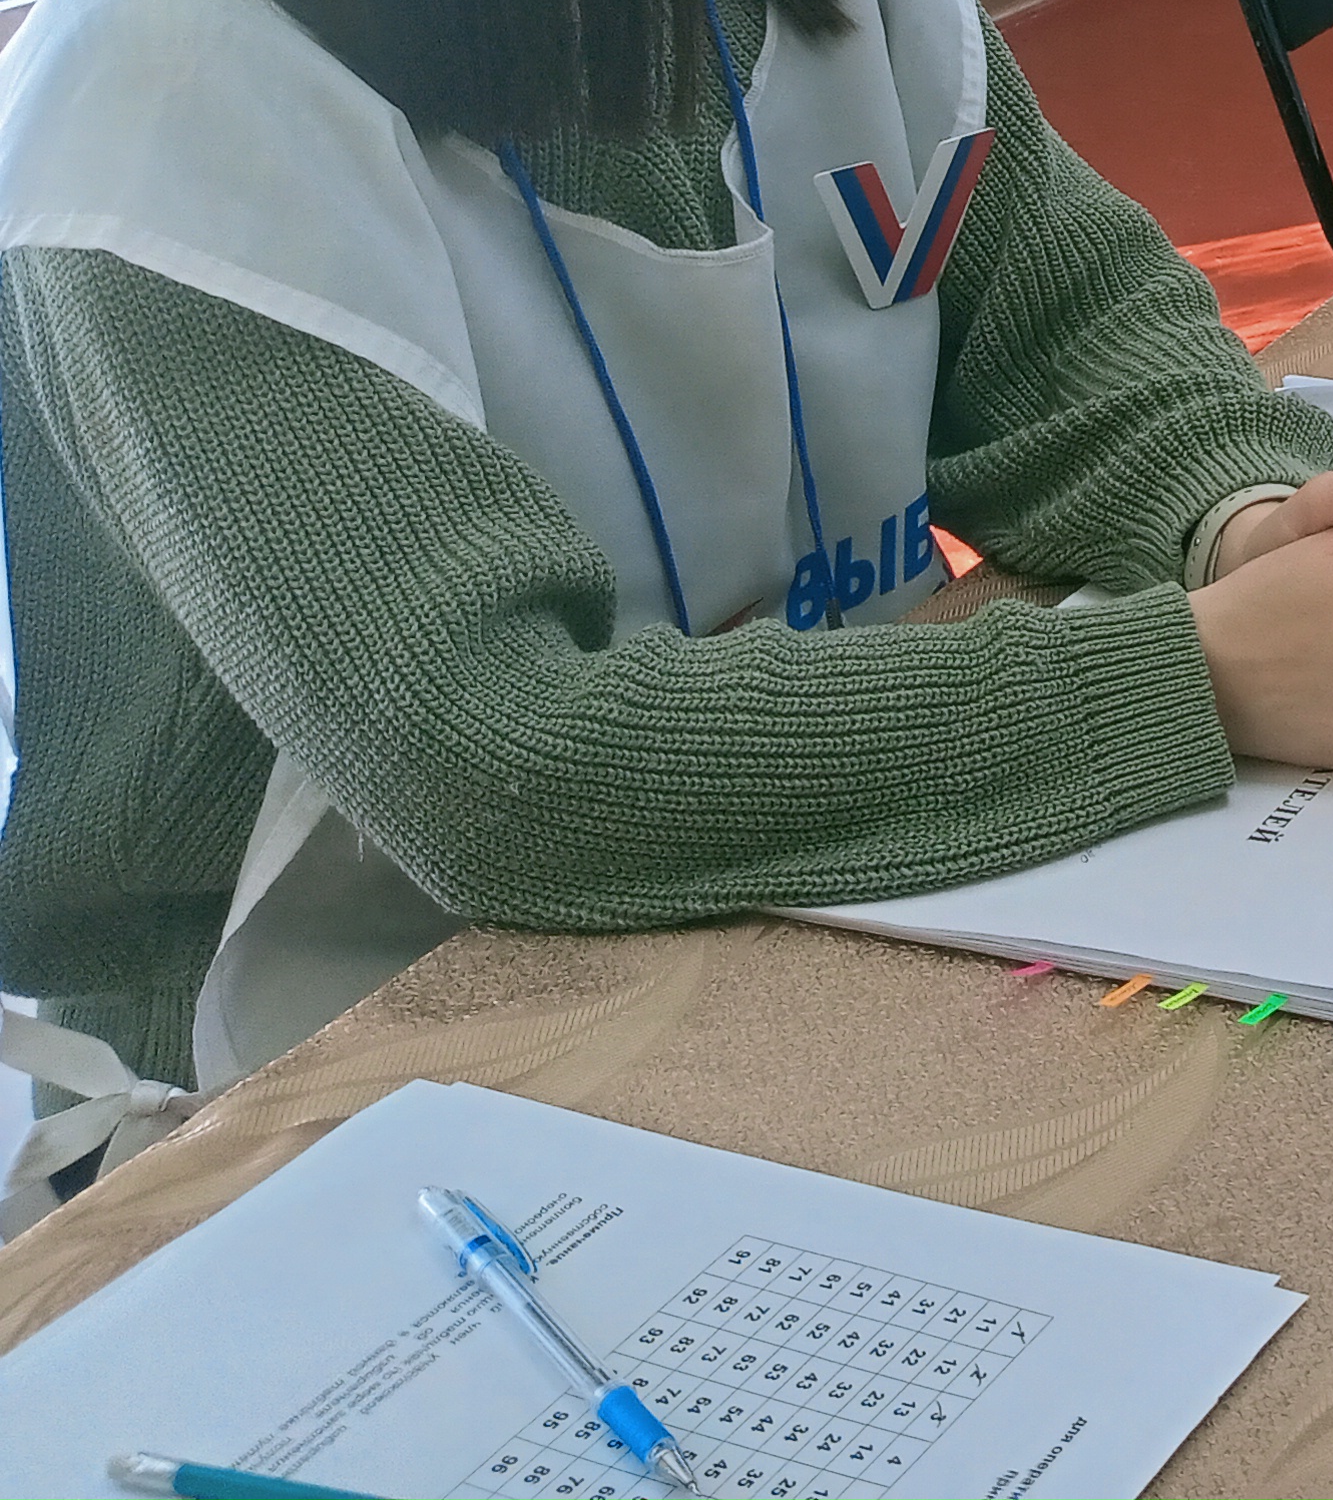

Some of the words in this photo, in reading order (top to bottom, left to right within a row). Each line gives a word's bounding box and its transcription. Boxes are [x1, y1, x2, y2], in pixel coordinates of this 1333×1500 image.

[546, 1207, 623, 1265] Примечание.
[728, 1251, 750, 1264] 91
[759, 1259, 781, 1273] 81
[789, 1268, 812, 1281] 71
[819, 1275, 841, 1289] 61
[683, 1289, 707, 1304] 92
[850, 1283, 872, 1297] 51
[714, 1297, 738, 1312] 82
[881, 1291, 900, 1306] 41
[912, 1299, 934, 1314] 31
[744, 1306, 770, 1321] 72
[944, 1308, 966, 1323] 21
[775, 1315, 799, 1330] 62
[976, 1319, 996, 1332] 11
[639, 1328, 663, 1344] 93
[807, 1323, 830, 1339] 52
[670, 1337, 694, 1353] 83
[838, 1332, 859, 1348] 42
[701, 1346, 727, 1362] 73
[870, 1340, 894, 1357] 32
[733, 1355, 756, 1371] 63
[902, 1349, 926, 1365] 22
[765, 1364, 788, 1380] 53
[934, 1360, 956, 1374] 12
[796, 1373, 818, 1389] 43
[655, 1389, 681, 1404] 74
[829, 1382, 852, 1398] 33
[687, 1397, 711, 1413] 64
[861, 1391, 884, 1407] 23
[719, 1406, 743, 1422] 54
[894, 1402, 915, 1416] 13
[543, 1412, 568, 1429] 95
[751, 1416, 773, 1432] 44
[575, 1422, 601, 1439] 85
[784, 1425, 809, 1441] 34
[1061, 1417, 1087, 1442] для
[817, 1434, 841, 1451] 24
[850, 1445, 873, 1460] 14
[887, 1456, 901, 1464] 4
[492, 1456, 518, 1473] 96
[704, 1460, 727, 1478] 45
[524, 1466, 550, 1484] 86
[738, 1469, 763, 1488] 35
[556, 1477, 584, 1494] 76
[771, 1478, 796, 1497] 25
